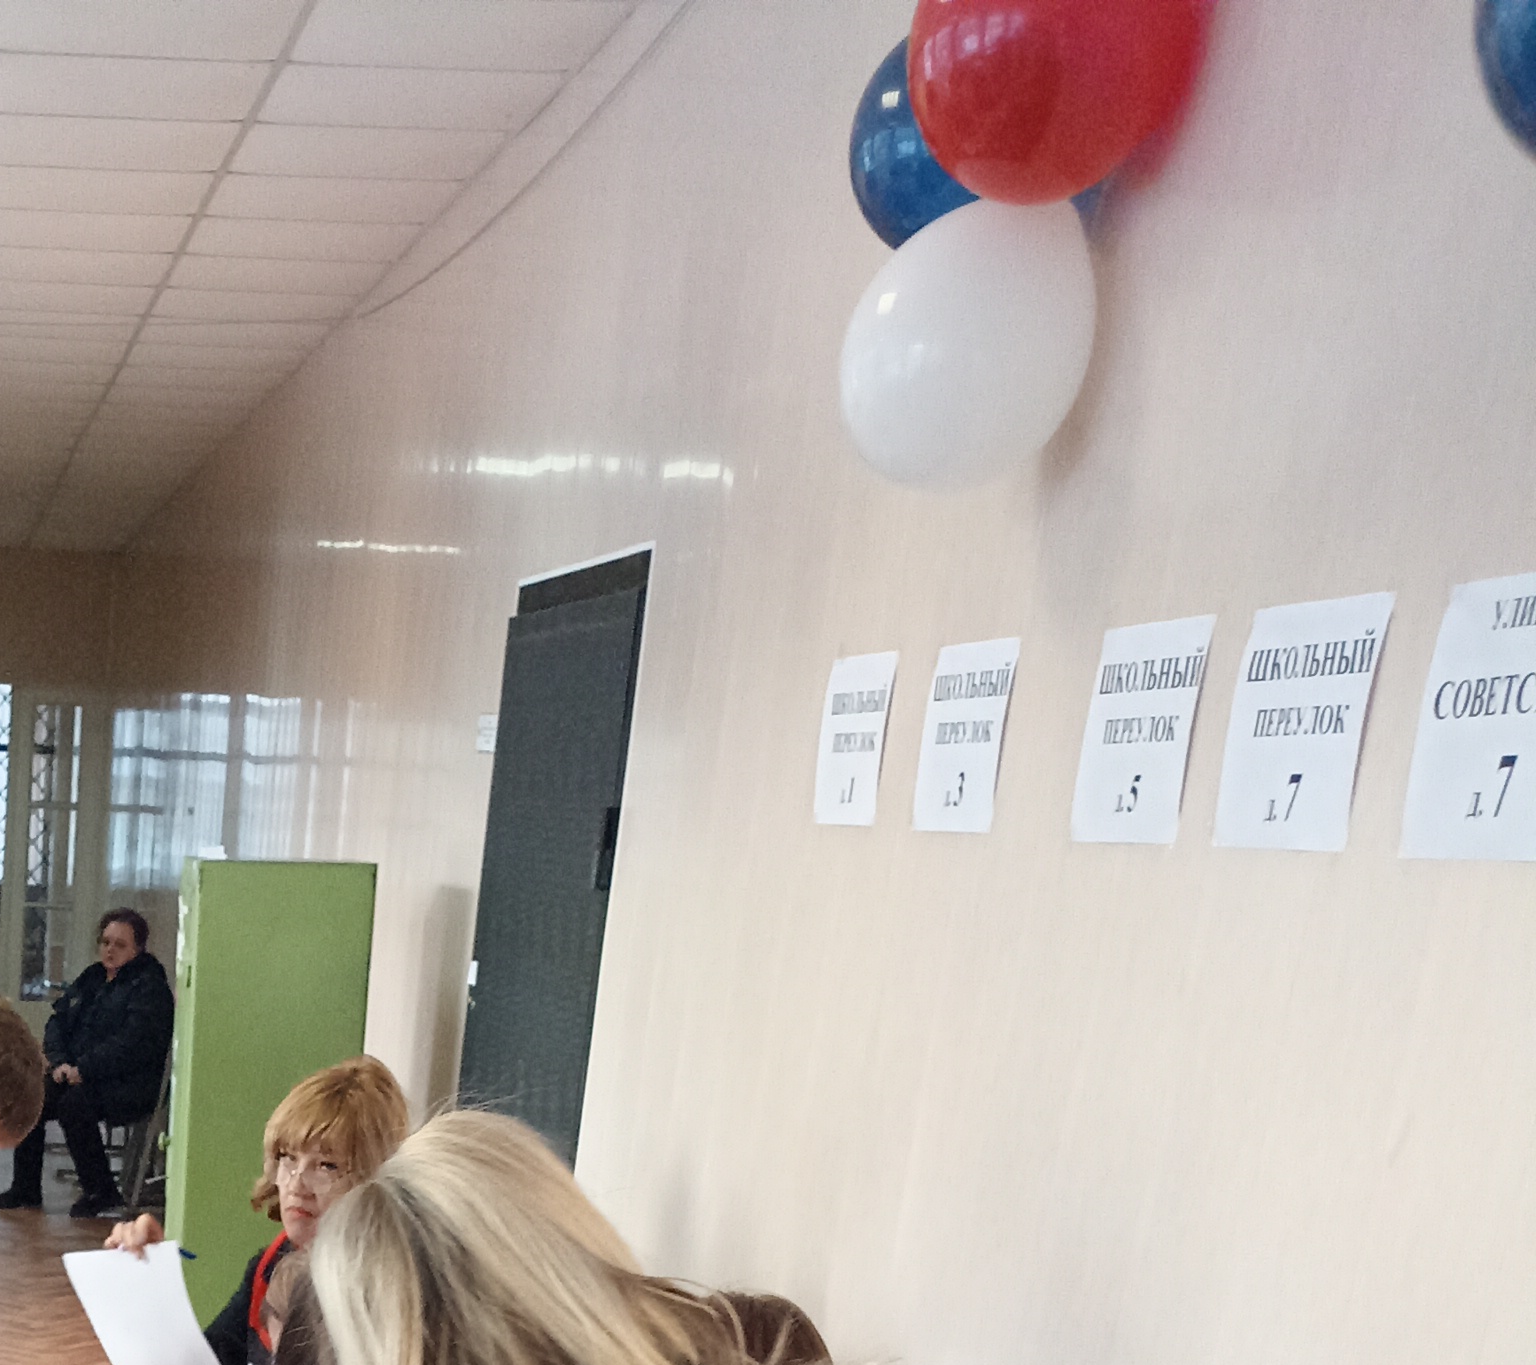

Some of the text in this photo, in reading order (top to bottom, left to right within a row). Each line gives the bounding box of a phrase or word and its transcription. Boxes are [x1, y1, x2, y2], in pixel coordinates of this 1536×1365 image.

[1099, 646, 1205, 695] ШКОЛЬНЫЙ
[1246, 628, 1376, 682] ШКОЛЬНЫЙ
[933, 661, 1012, 702] ШКОЛЬНЫЙ
[1433, 672, 1536, 720] СОВЕТС
[1103, 715, 1180, 745] ПЕРЕУЛОК
[1253, 704, 1350, 737] ПЕРЕУЛОК
